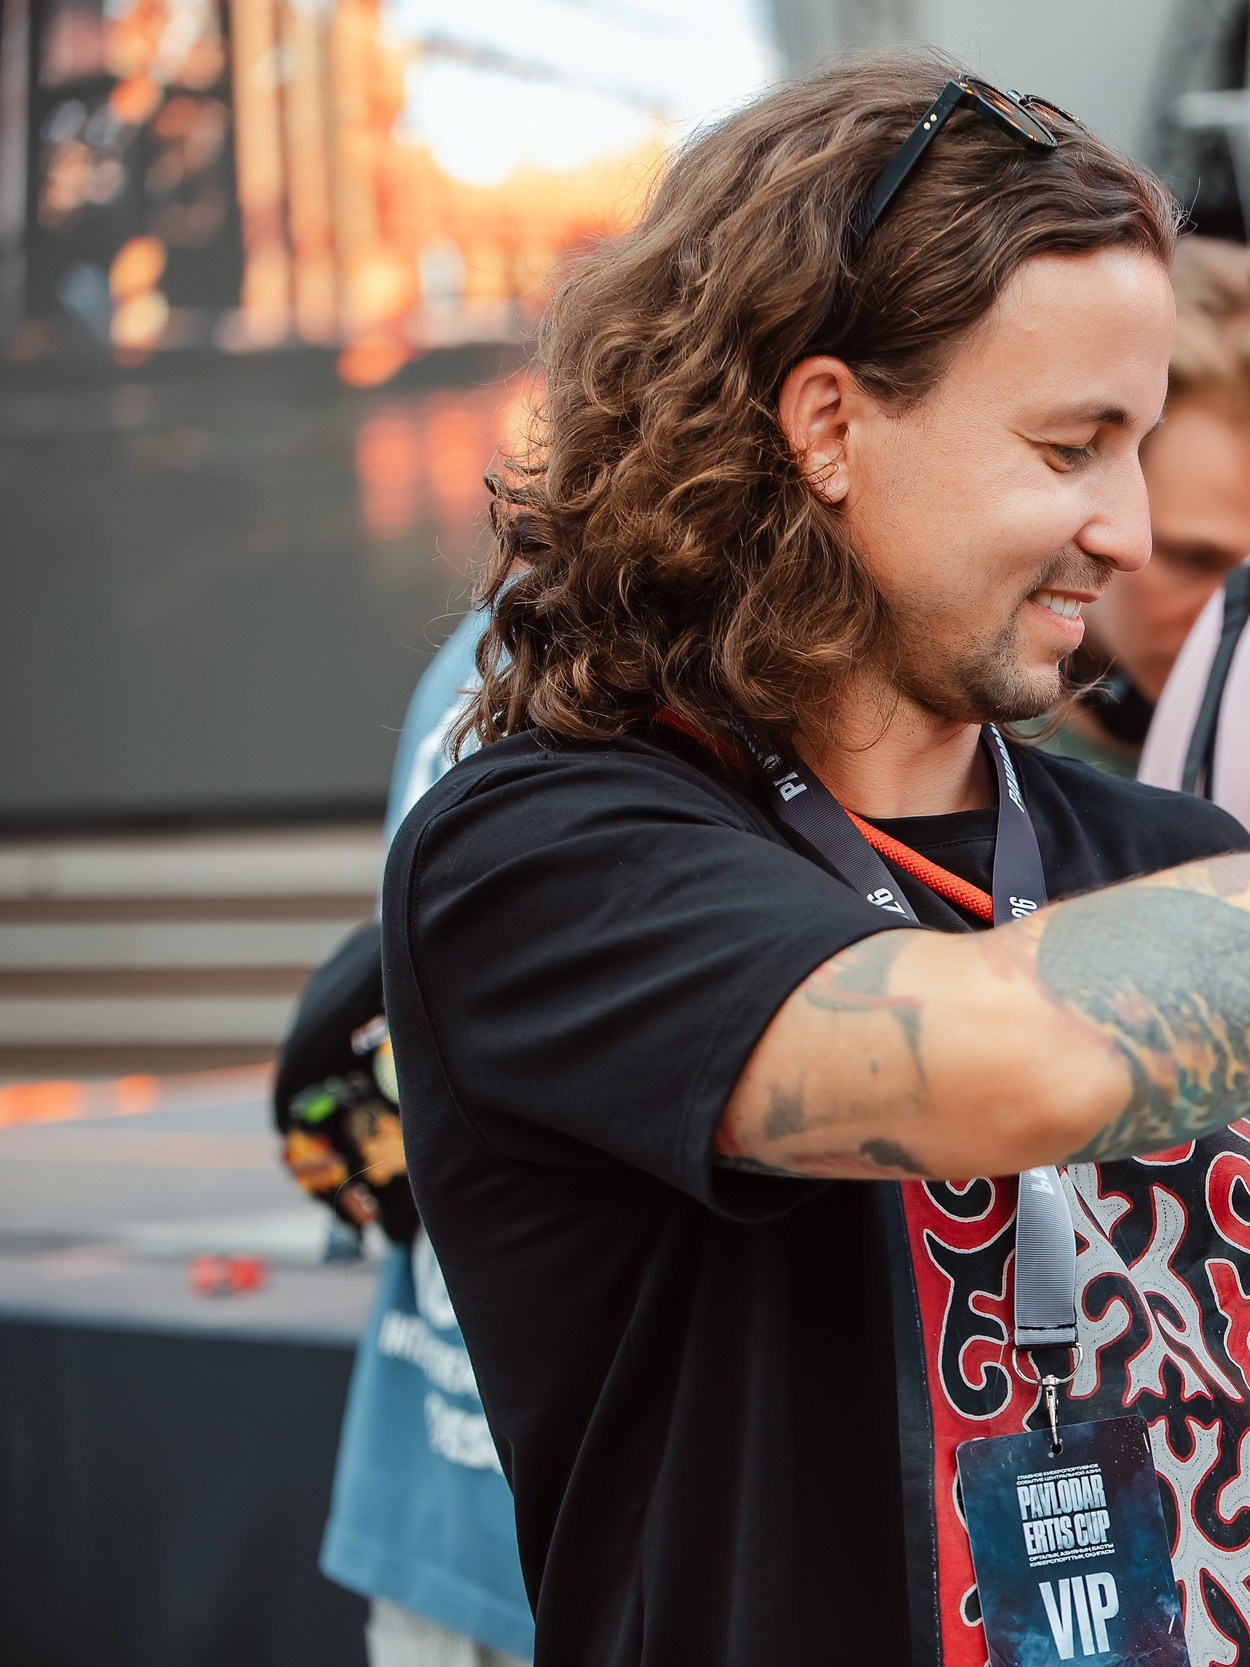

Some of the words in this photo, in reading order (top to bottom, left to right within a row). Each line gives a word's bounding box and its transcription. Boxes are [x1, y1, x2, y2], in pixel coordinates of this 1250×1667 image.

[989, 722, 1025, 813] PAVLODA
[1016, 1474, 1107, 1520] PAVLODAR
[1022, 1515, 1075, 1556] ERTIS
[1073, 1509, 1111, 1547] CUP
[1038, 1571, 1120, 1661] VIP
